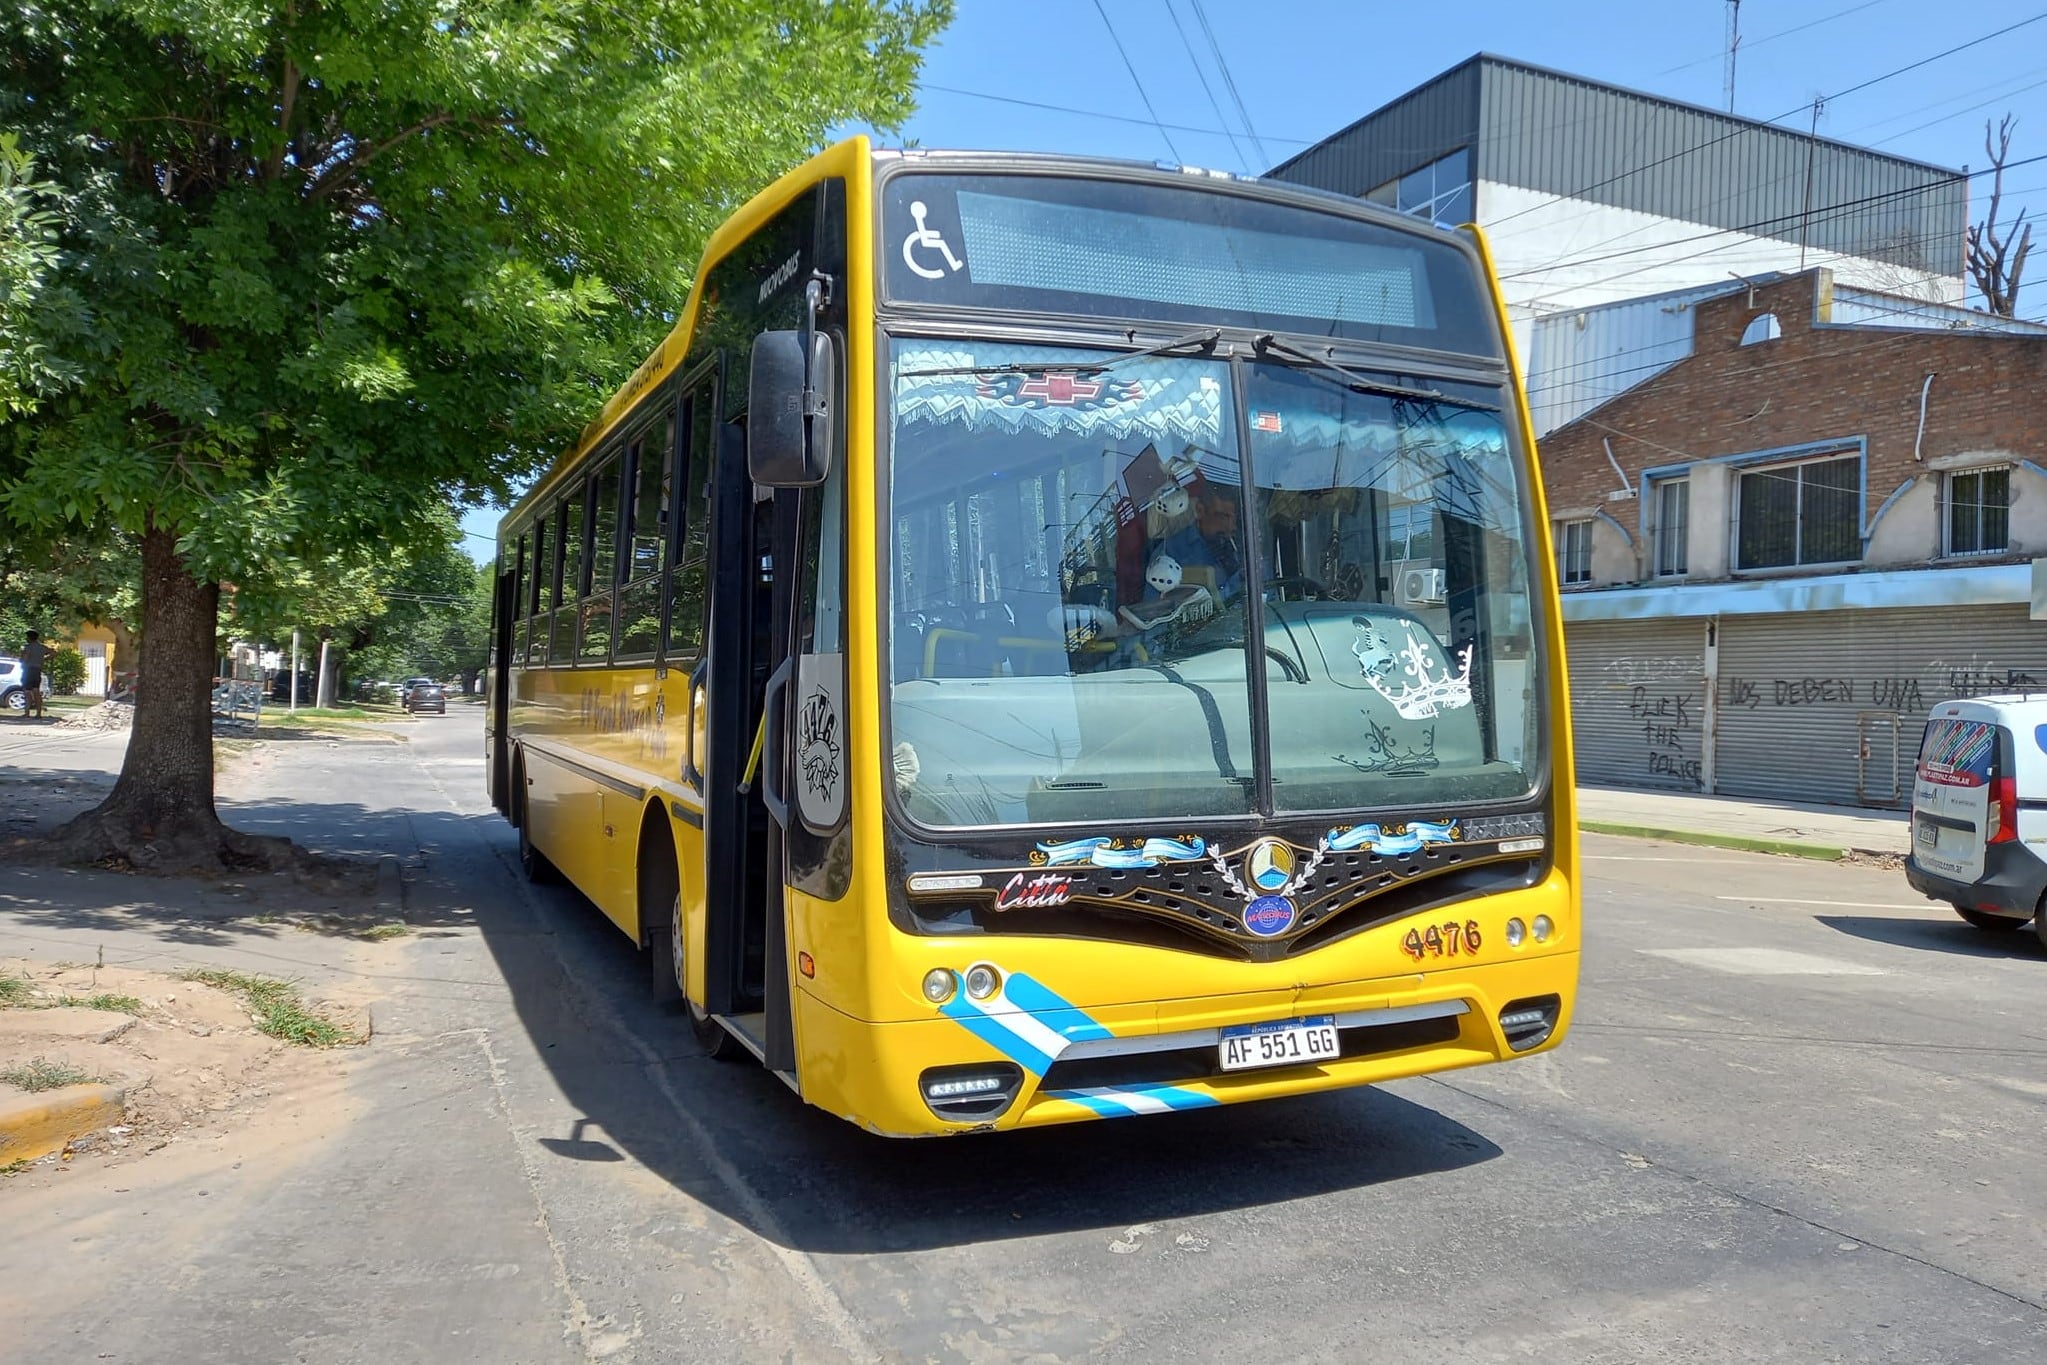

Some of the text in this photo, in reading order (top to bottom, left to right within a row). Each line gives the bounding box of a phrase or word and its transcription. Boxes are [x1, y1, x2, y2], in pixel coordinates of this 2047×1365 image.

[1729, 676, 1761, 709] NOS
[1775, 677, 1854, 706] DEBEN
[1873, 679, 1923, 713] UNA
[1642, 720, 1684, 752] THE
[1402, 919, 1482, 961] 4476
[1227, 1028, 1334, 1064] AF 551 GG
